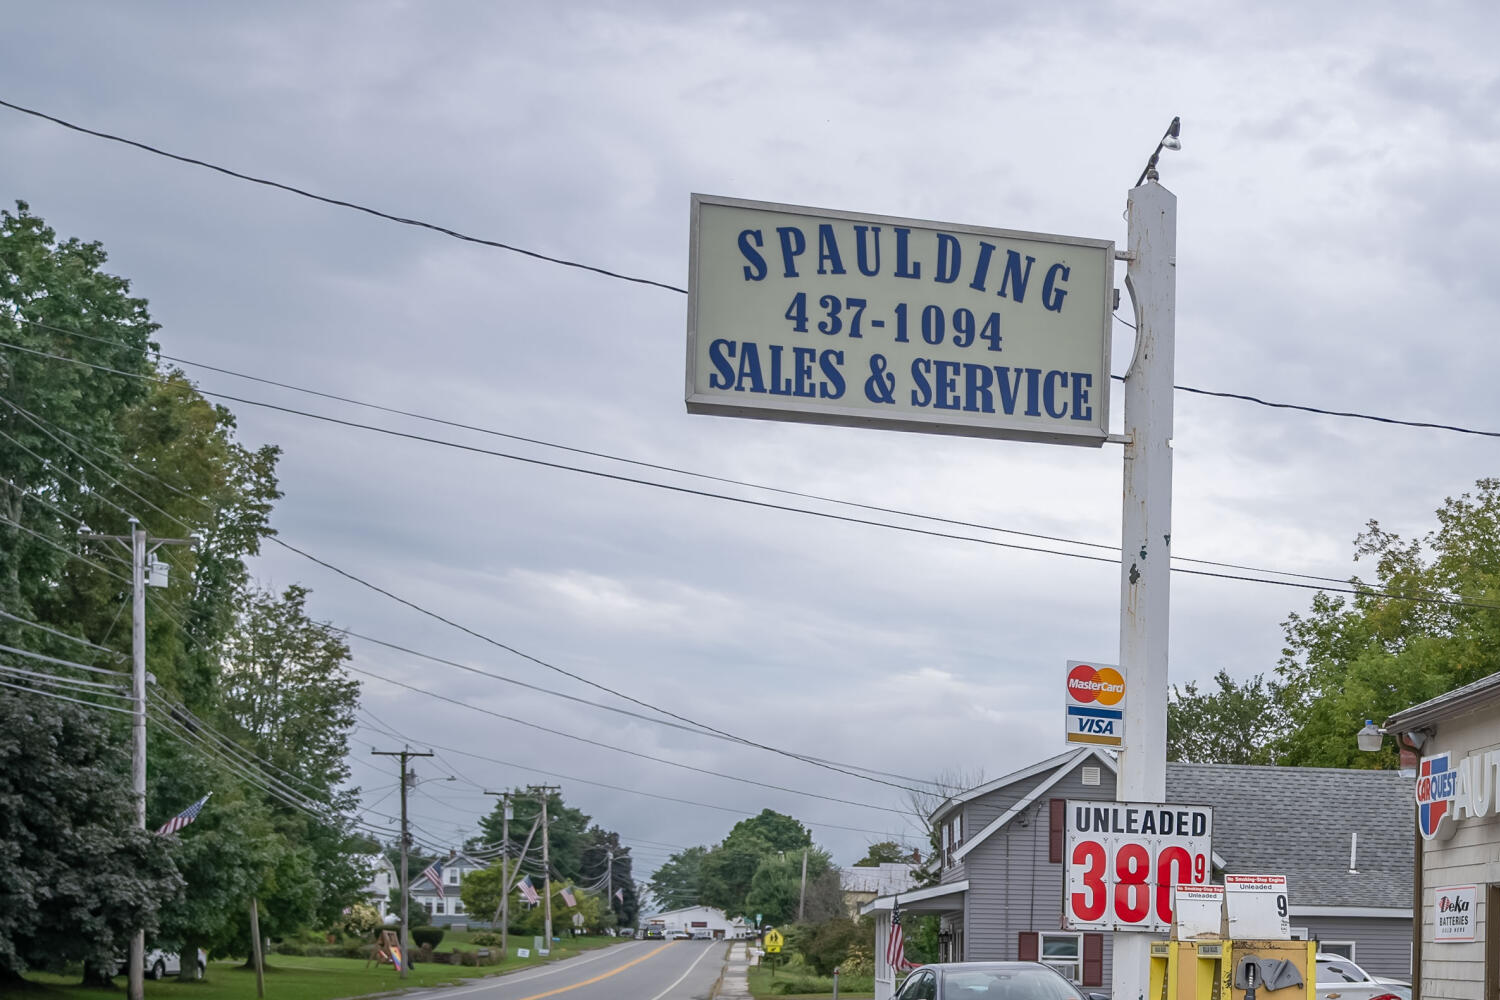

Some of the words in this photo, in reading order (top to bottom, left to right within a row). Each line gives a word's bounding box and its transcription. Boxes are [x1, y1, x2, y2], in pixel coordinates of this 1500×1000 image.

[737, 223, 1071, 313] SPAULDING
[784, 291, 1003, 352] 437-1094
[708, 338, 846, 400] SALES
[864, 353, 896, 404] &
[911, 357, 1093, 421] SERVICE
[1069, 678, 1123, 693] MasterCard
[1078, 718, 1114, 734] VISA
[1076, 807, 1207, 837] UNLEADED
[1277, 895, 1288, 917] 9
[1440, 896, 1469, 913] Deka
[1440, 915, 1468, 926] BATTERIES
